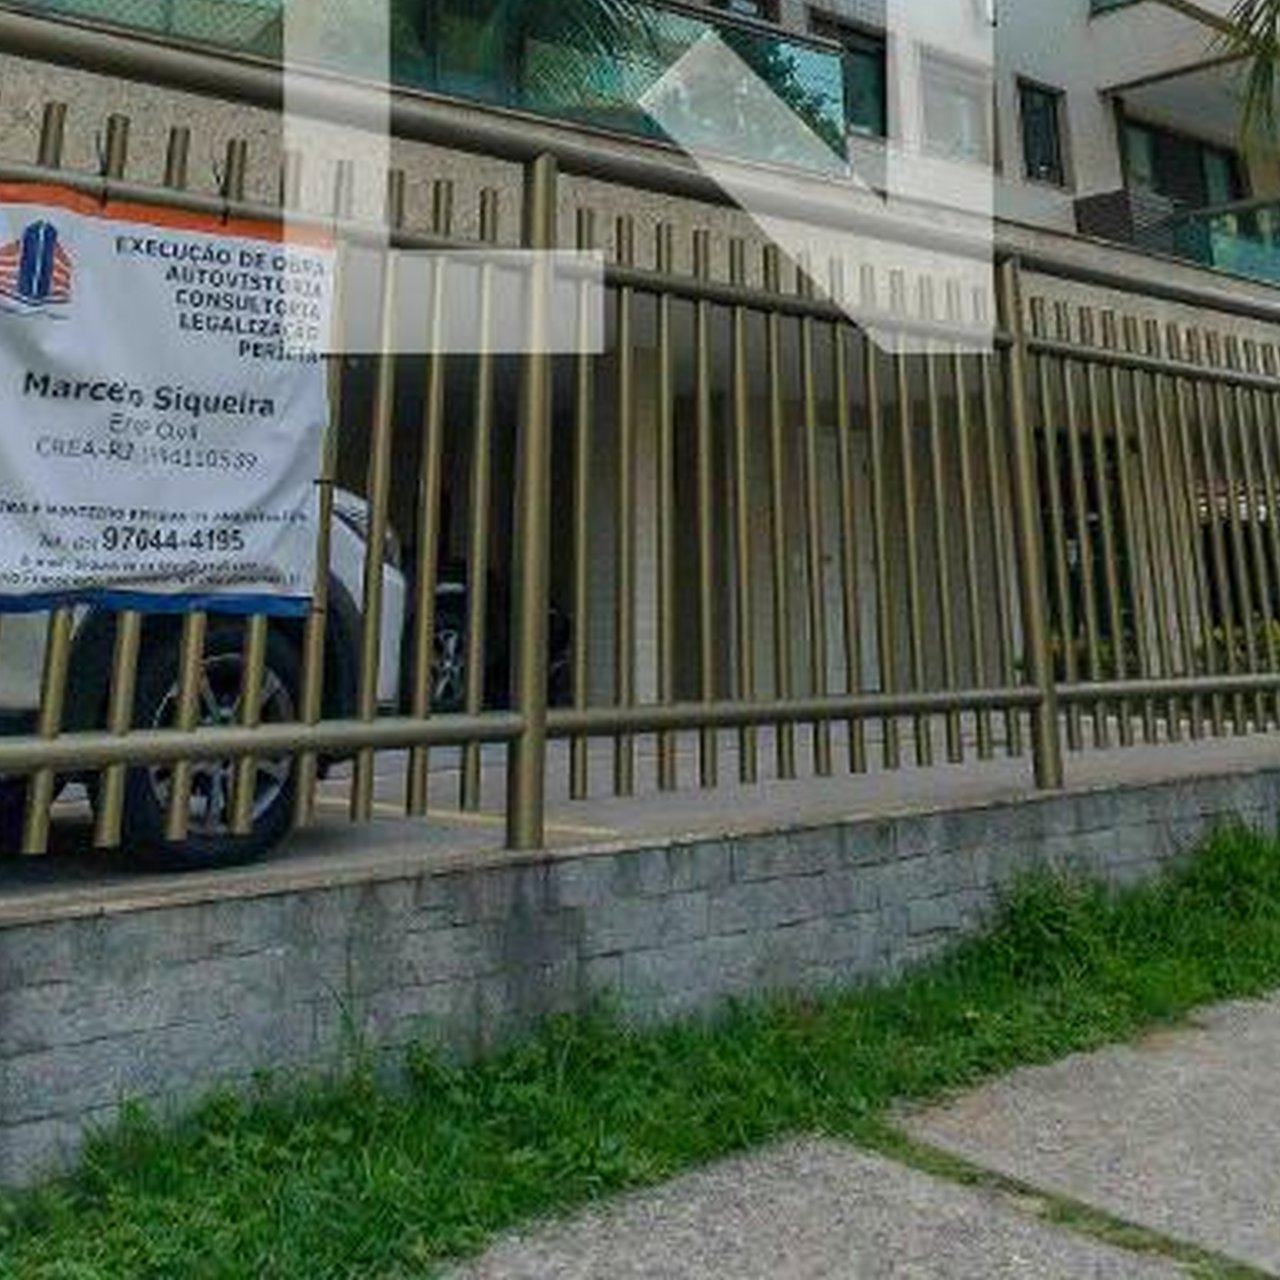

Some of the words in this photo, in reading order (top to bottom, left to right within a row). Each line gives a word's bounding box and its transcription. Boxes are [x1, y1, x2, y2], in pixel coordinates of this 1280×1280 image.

[115, 235, 231, 265] EXECUÇÃO
[239, 250, 267, 271] DE
[153, 385, 276, 418] Siqueira
[102, 525, 245, 551] 97044-4195
